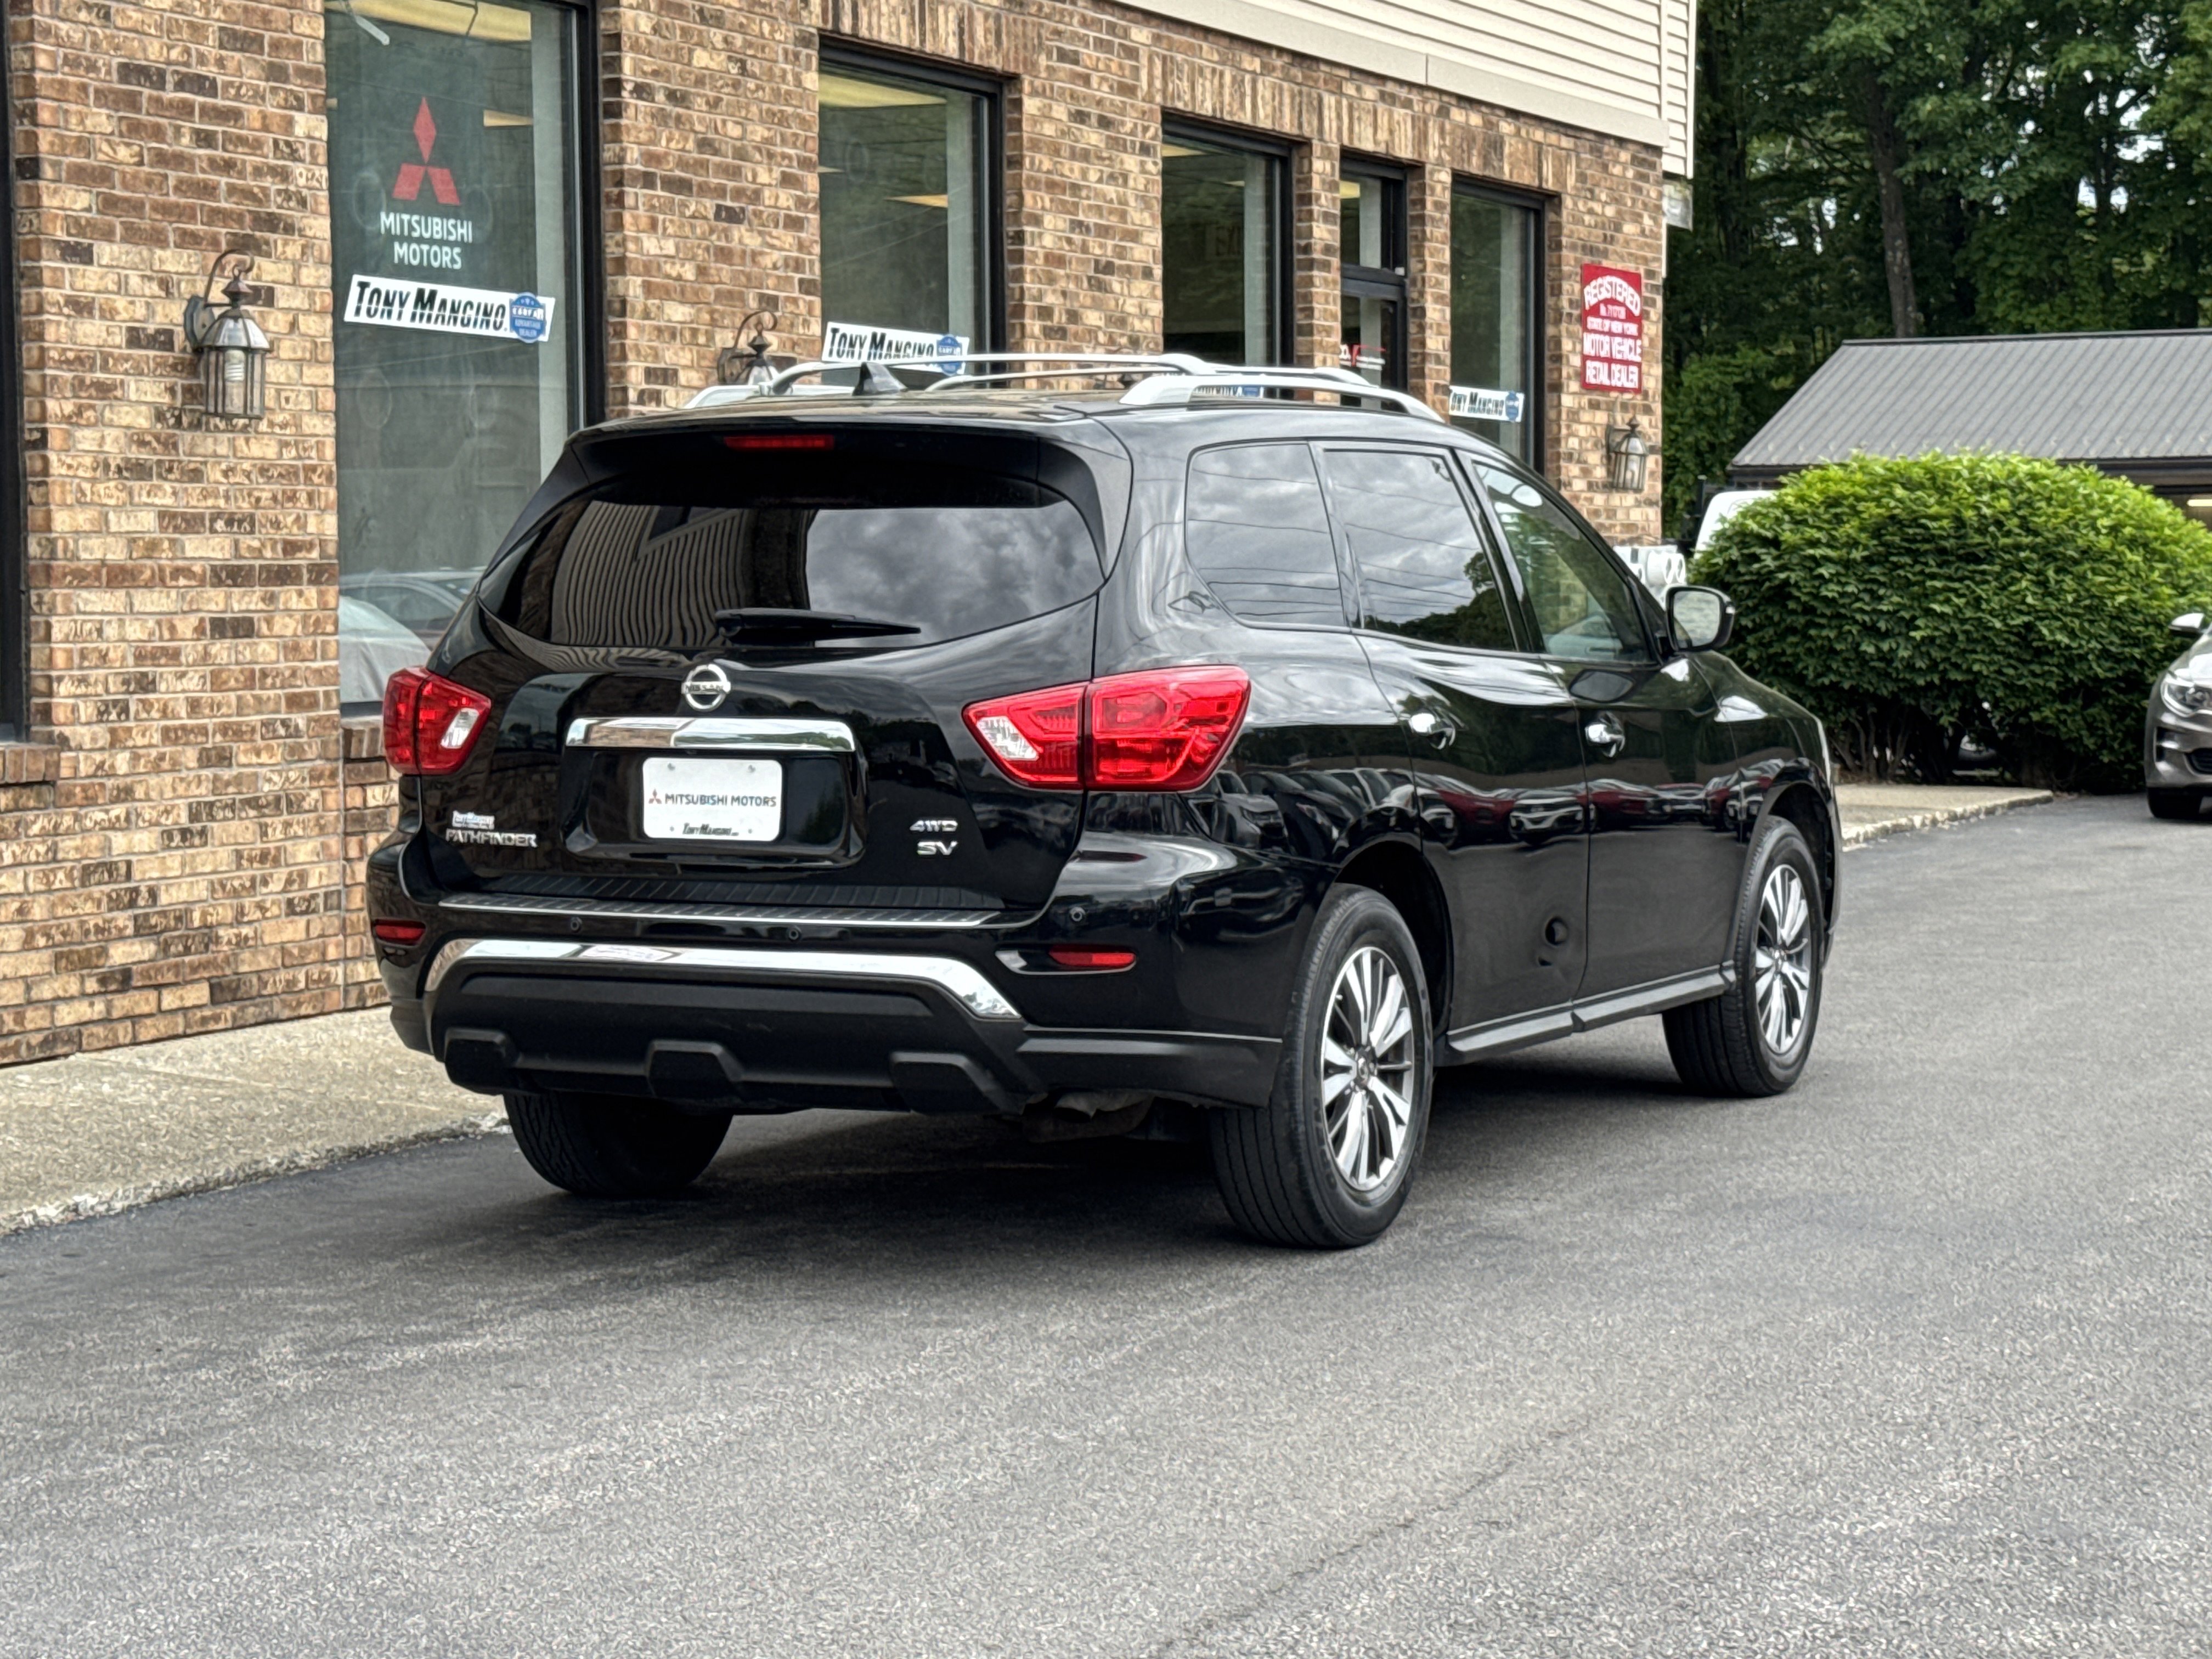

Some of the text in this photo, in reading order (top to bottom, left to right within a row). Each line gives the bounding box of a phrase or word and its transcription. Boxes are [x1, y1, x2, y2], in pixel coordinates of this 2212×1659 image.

[380, 212, 472, 243] MITSUBISHI
[1215, 225, 1242, 257] EXI
[394, 242, 462, 269] MOTORS
[354, 280, 410, 321] TONY
[1584, 275, 1640, 317] REGISTERED
[828, 328, 867, 360] TONY
[1583, 331, 1641, 362] MOTOR VEHICLE
[1585, 360, 1638, 388] RETAIL DEALER
[1450, 391, 1468, 413] ONY
[665, 793, 777, 807] MITSUBISHI MOTORS
[445, 828, 538, 848] PATHFINDER
[917, 841, 957, 855] SV
